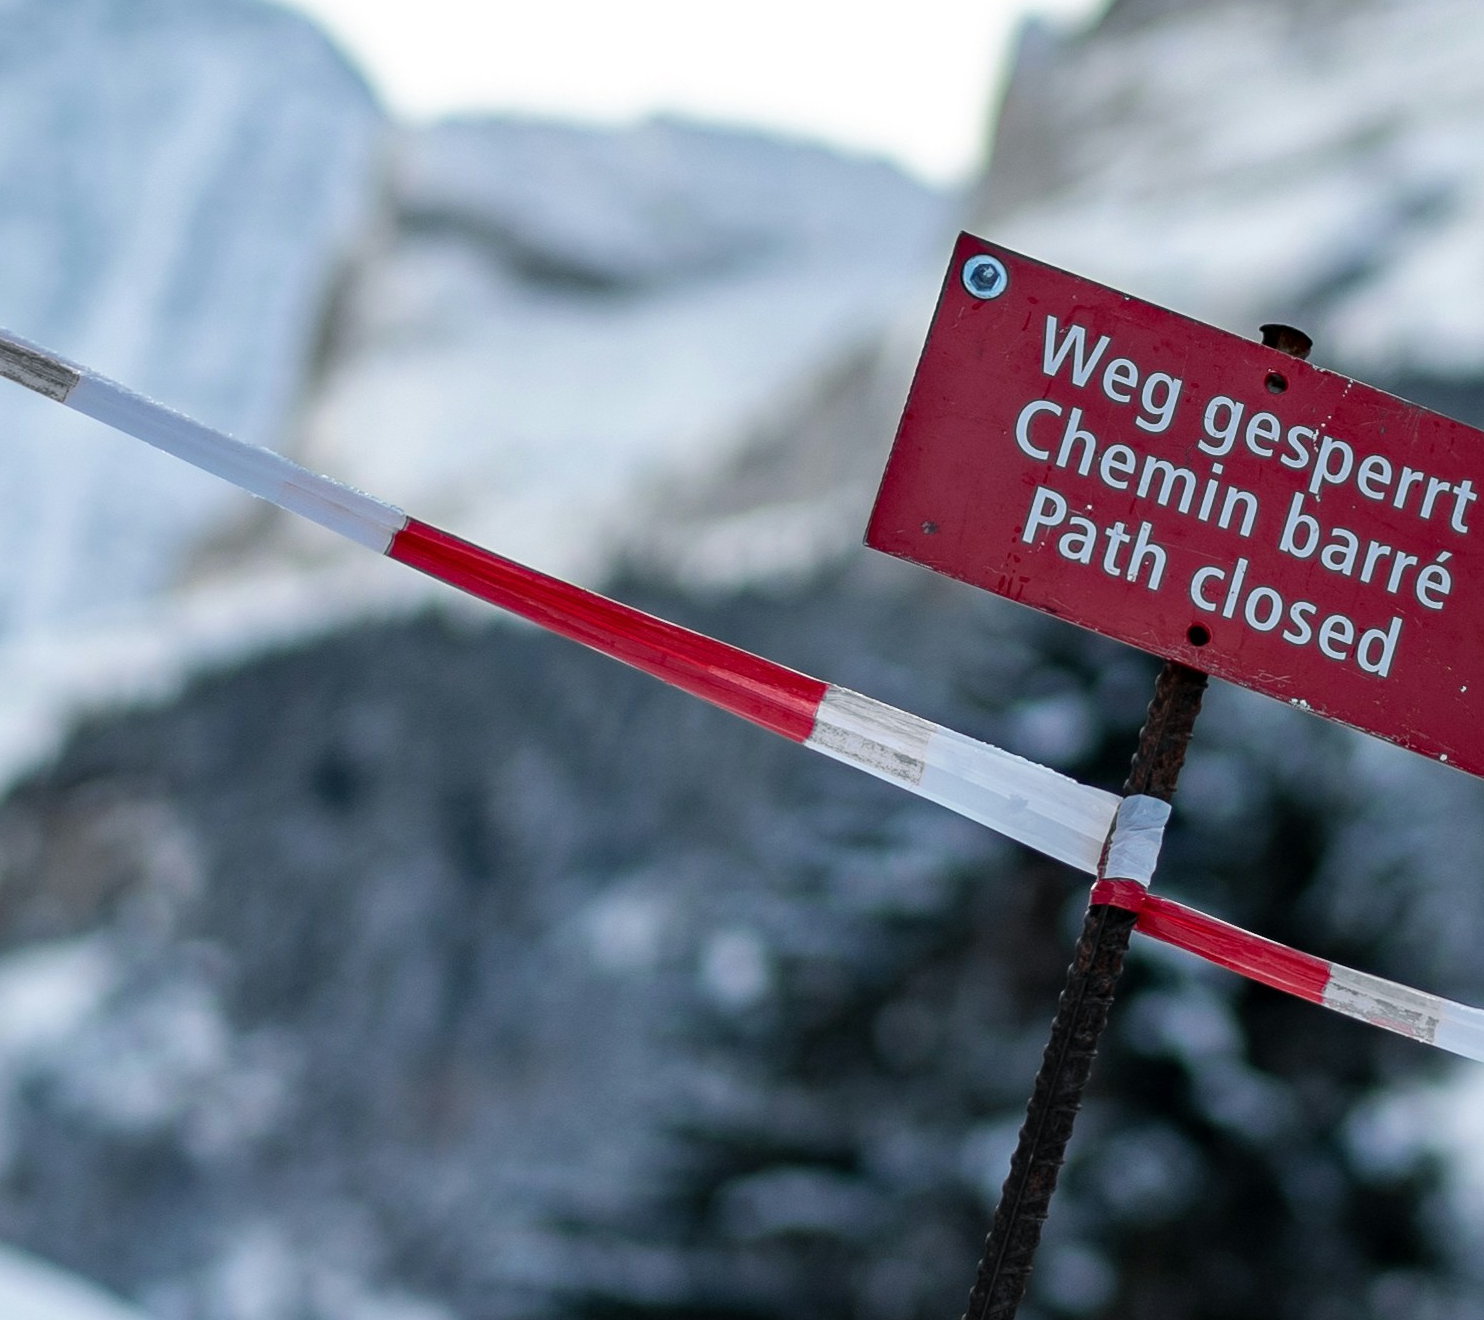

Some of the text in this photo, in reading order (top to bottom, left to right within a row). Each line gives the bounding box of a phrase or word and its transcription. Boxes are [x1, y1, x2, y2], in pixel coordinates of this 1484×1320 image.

[1015, 400, 1453, 610] Chemin barré
[1042, 314, 1478, 534] Weg gesperrt
[1021, 486, 1403, 678] Path closed
